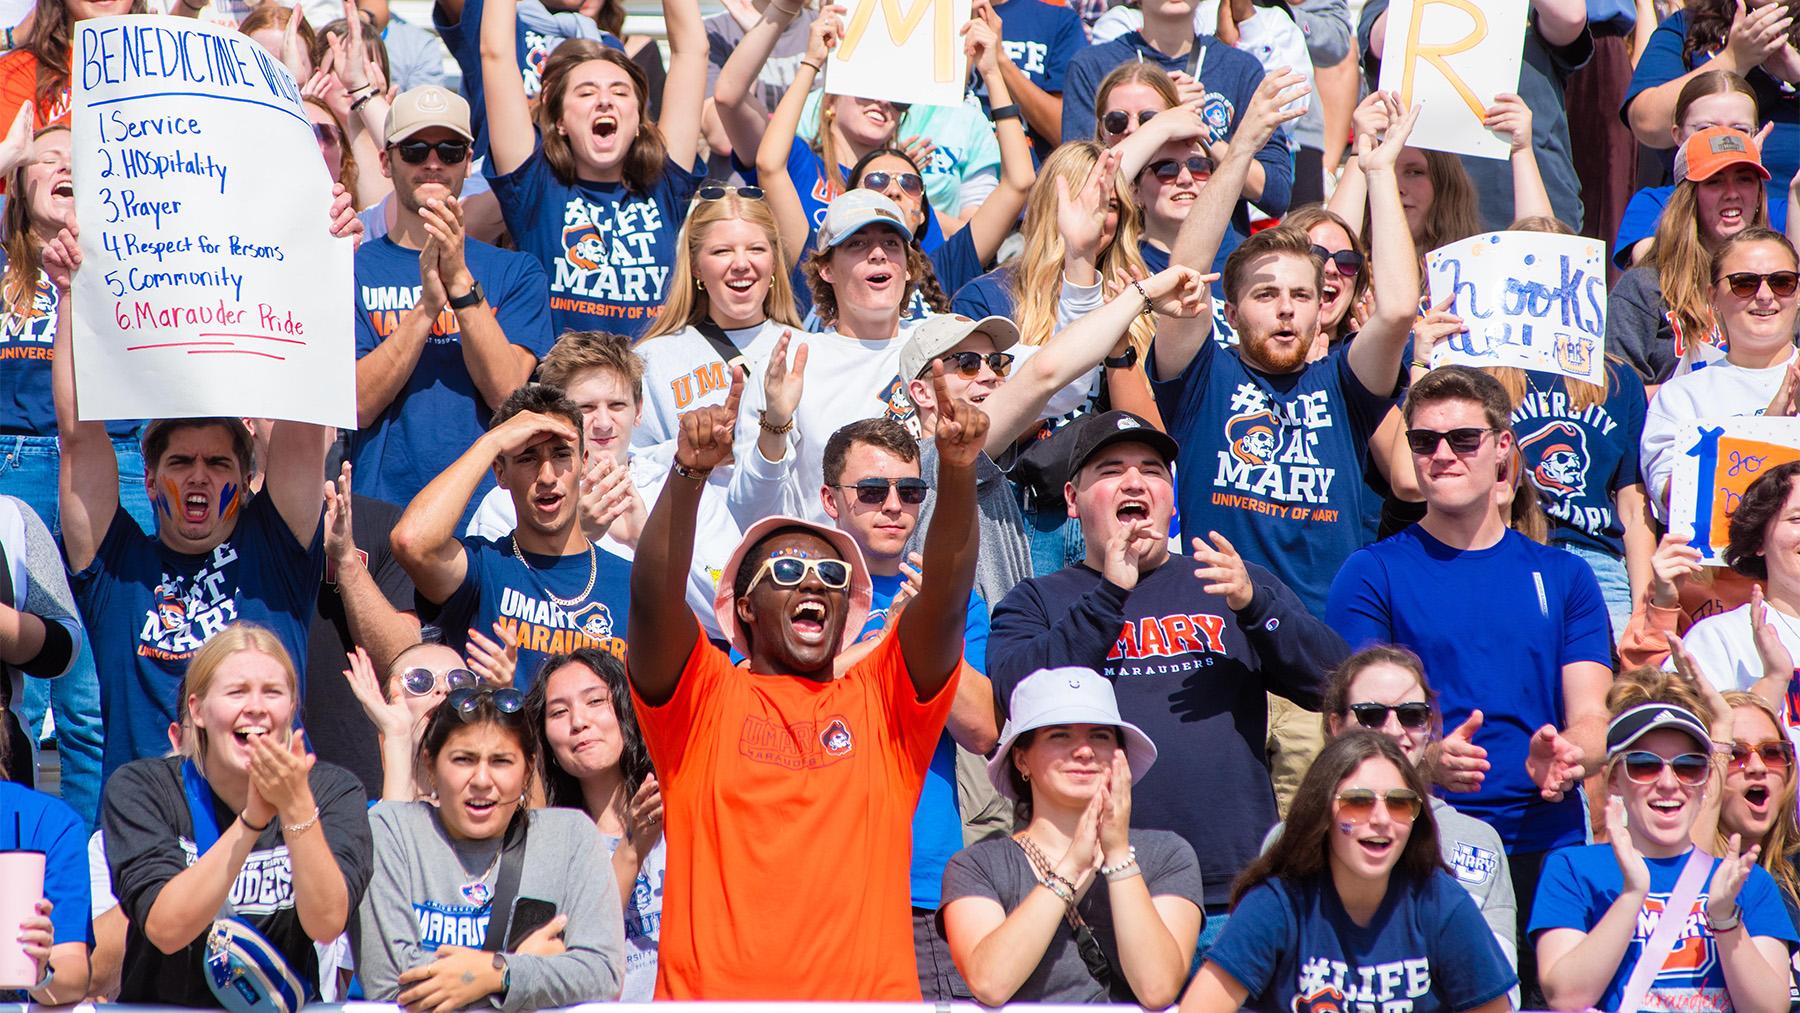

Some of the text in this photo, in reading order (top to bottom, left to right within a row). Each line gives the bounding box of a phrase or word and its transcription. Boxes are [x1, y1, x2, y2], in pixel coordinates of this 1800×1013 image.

[83, 25, 255, 90] BENEDICTINE
[837, 0, 955, 83] M
[1400, 0, 1489, 127] R
[198, 235, 221, 254] for
[228, 235, 285, 261] Persons
[362, 285, 423, 311] UMA
[551, 257, 669, 301] MARY
[258, 303, 304, 335] Pride
[550, 297, 627, 319] UNIVERSITY
[627, 305, 645, 319] OF
[0, 346, 55, 360] UNIVERS
[1213, 450, 1336, 503] MARY
[1211, 492, 1289, 519] UNIVERSITY
[1291, 507, 1311, 520] OF
[500, 587, 576, 629] UMARY
[1106, 613, 1227, 660] MARY
[1104, 657, 1214, 676] MARAUDERS
[1299, 955, 1432, 1003] #LIFE
